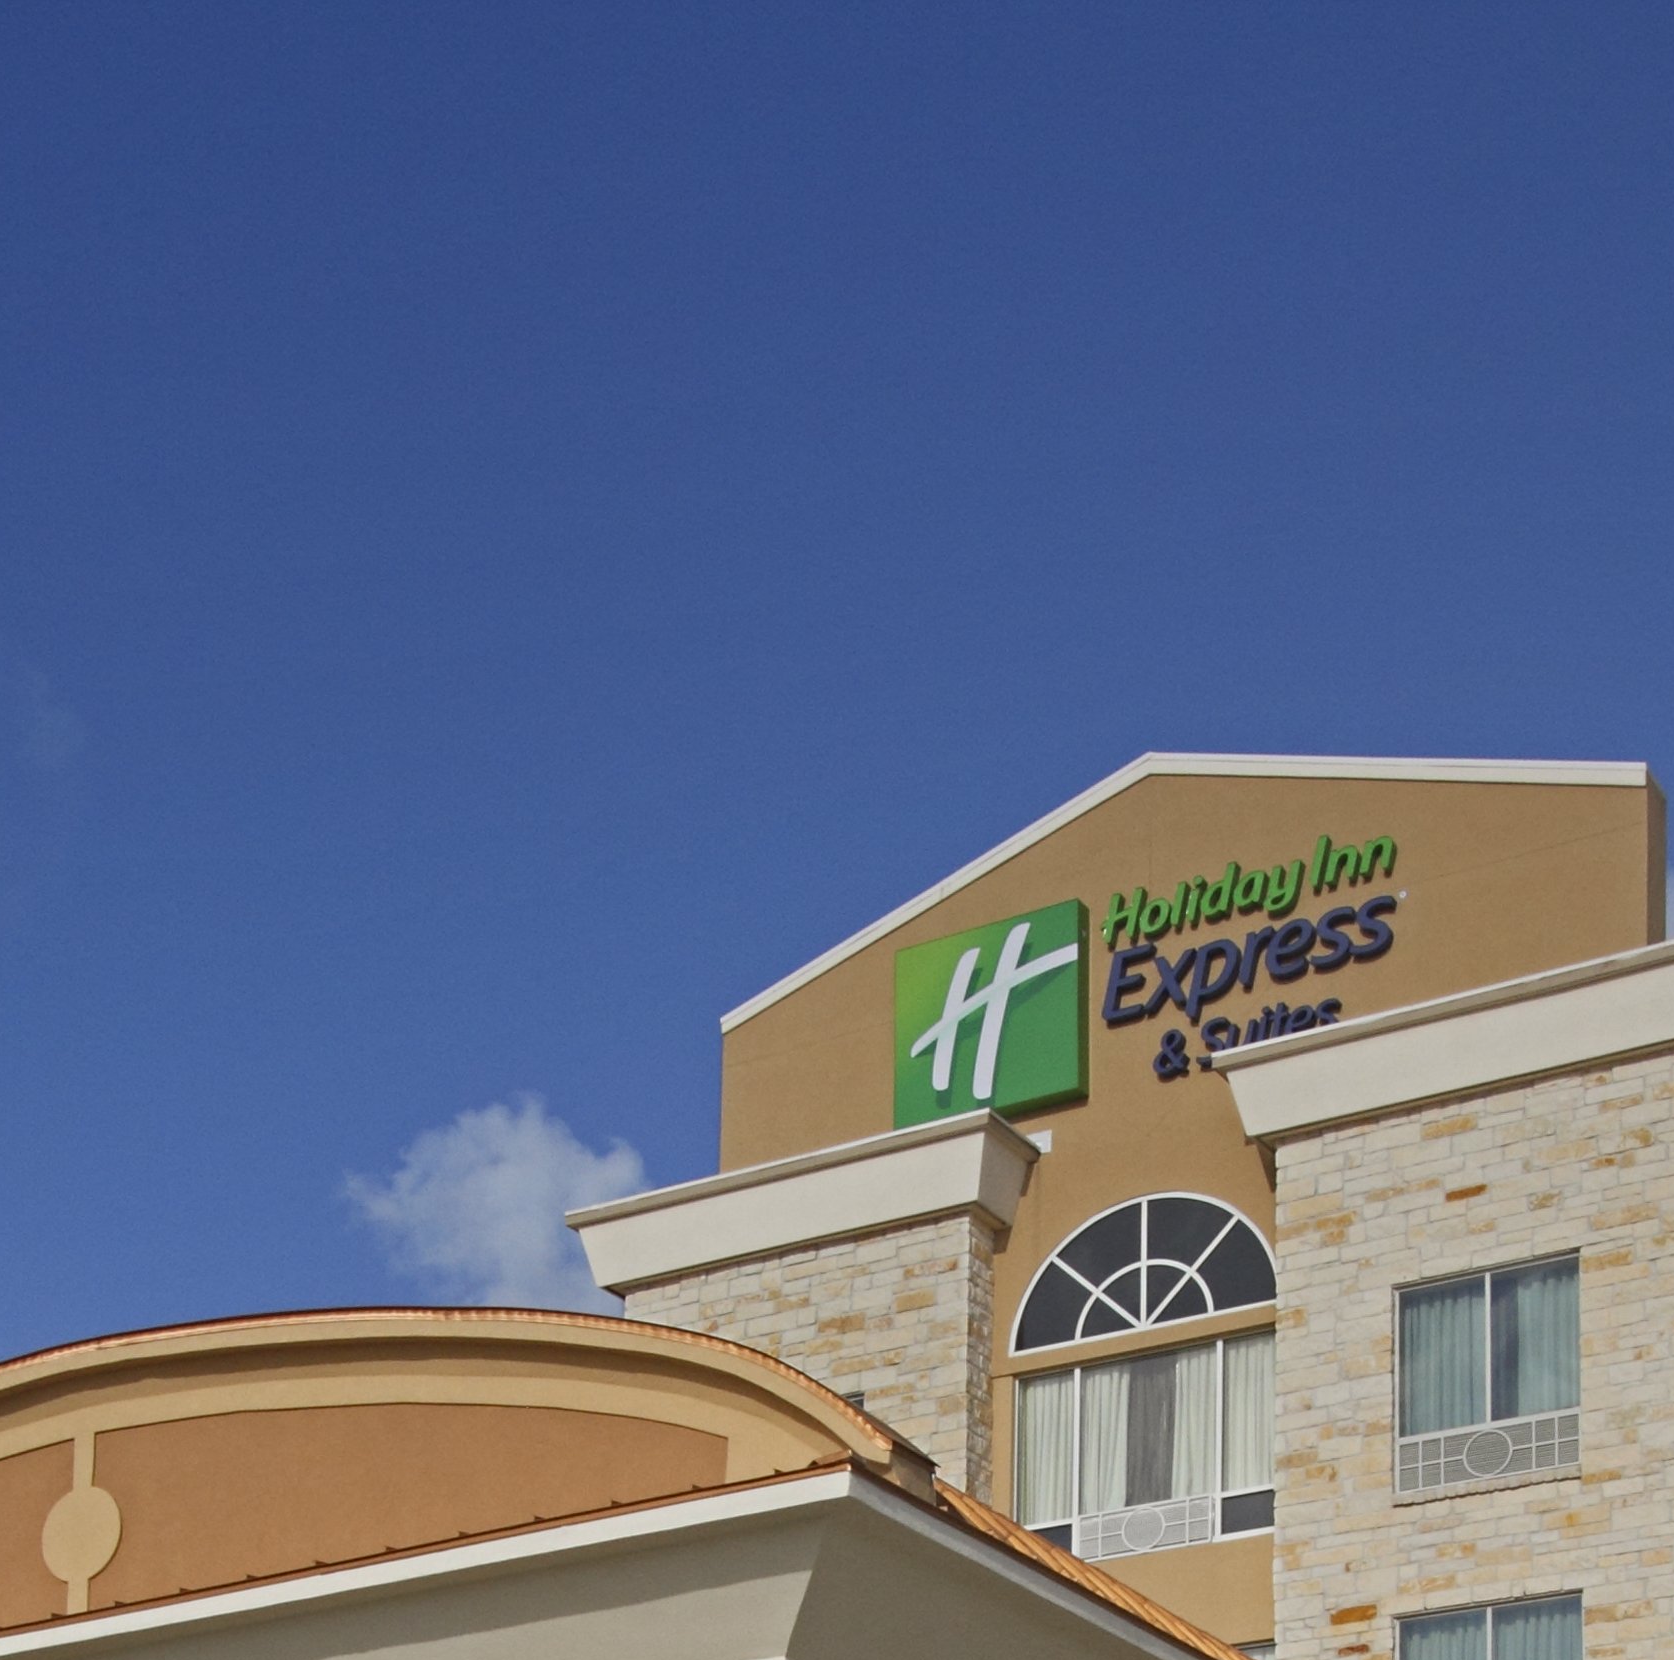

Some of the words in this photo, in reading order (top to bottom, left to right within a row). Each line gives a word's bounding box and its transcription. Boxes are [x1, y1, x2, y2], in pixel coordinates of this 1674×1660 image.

[1102, 860, 1305, 945] Holiday
[1309, 833, 1397, 893] Inn
[1101, 894, 1398, 1028] Express
[1152, 1028, 1191, 1083] &
[1196, 997, 1343, 1070] Suites
